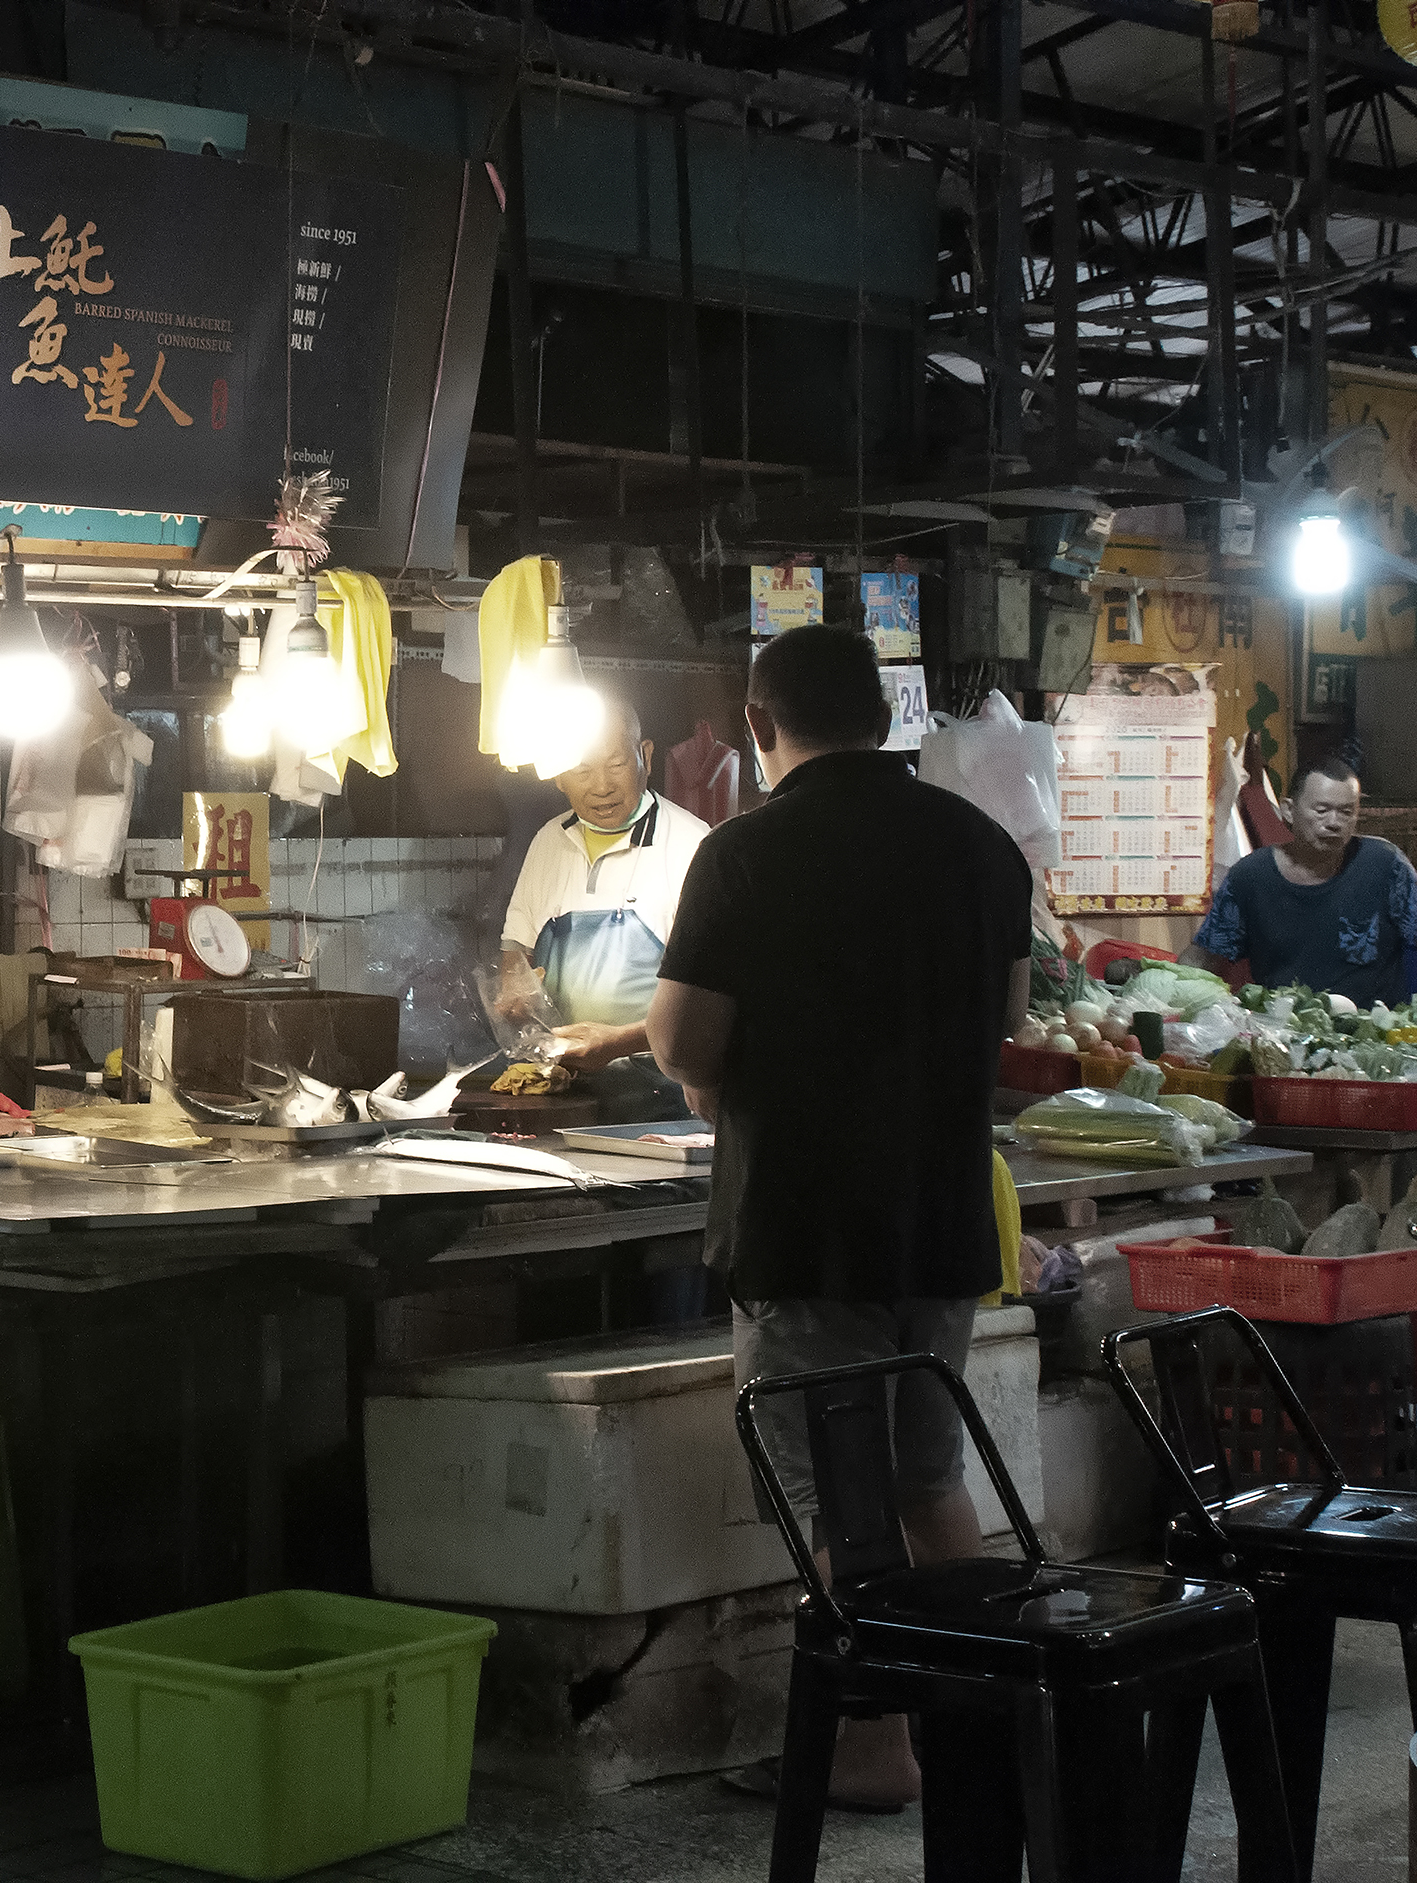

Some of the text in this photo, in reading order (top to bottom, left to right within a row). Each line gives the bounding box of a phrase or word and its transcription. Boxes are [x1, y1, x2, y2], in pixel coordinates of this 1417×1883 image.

[300, 221, 357, 246] since 1951
[75, 302, 234, 333] BARRED SPANISH MACKEREL
[157, 333, 233, 353] CONNOISSEUR
[900, 686, 926, 725] 24
